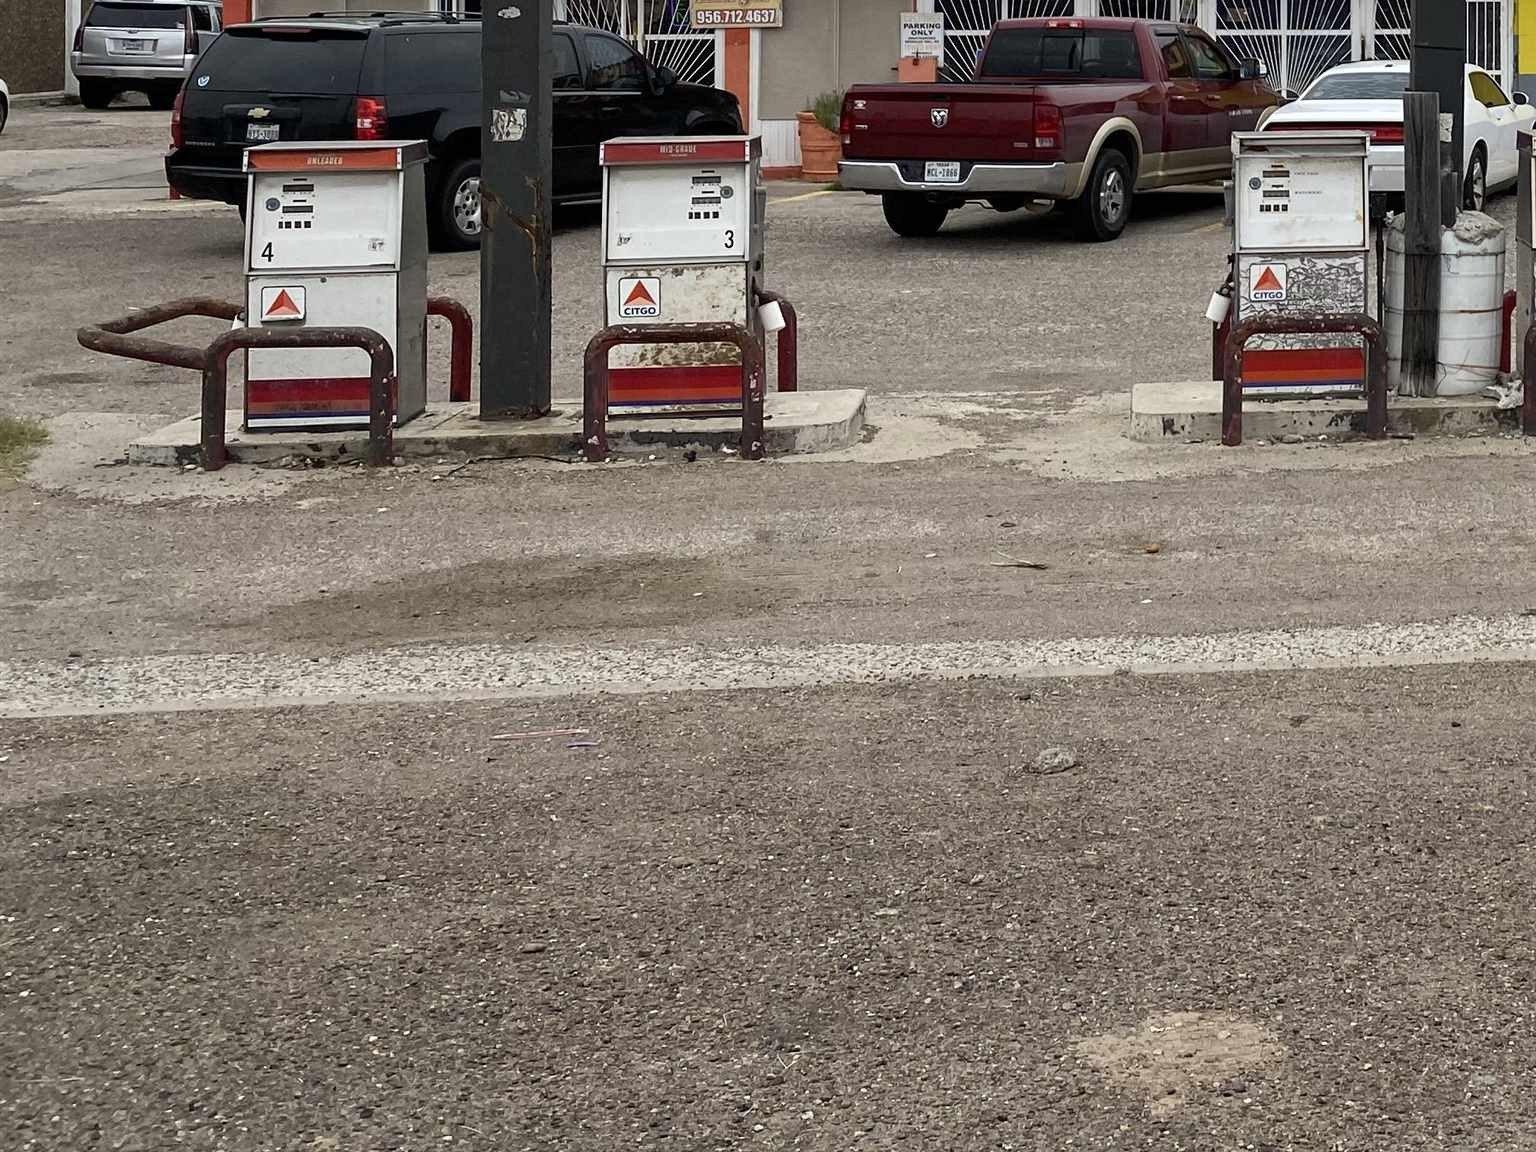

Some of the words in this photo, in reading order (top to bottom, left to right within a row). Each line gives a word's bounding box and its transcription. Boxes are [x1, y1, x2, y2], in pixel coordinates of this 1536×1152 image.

[696, 9, 776, 24] 956.712.4637
[724, 230, 735, 248] 3
[261, 242, 275, 262] 4
[1253, 291, 1283, 300] CITGO
[624, 307, 656, 315] CITGO
